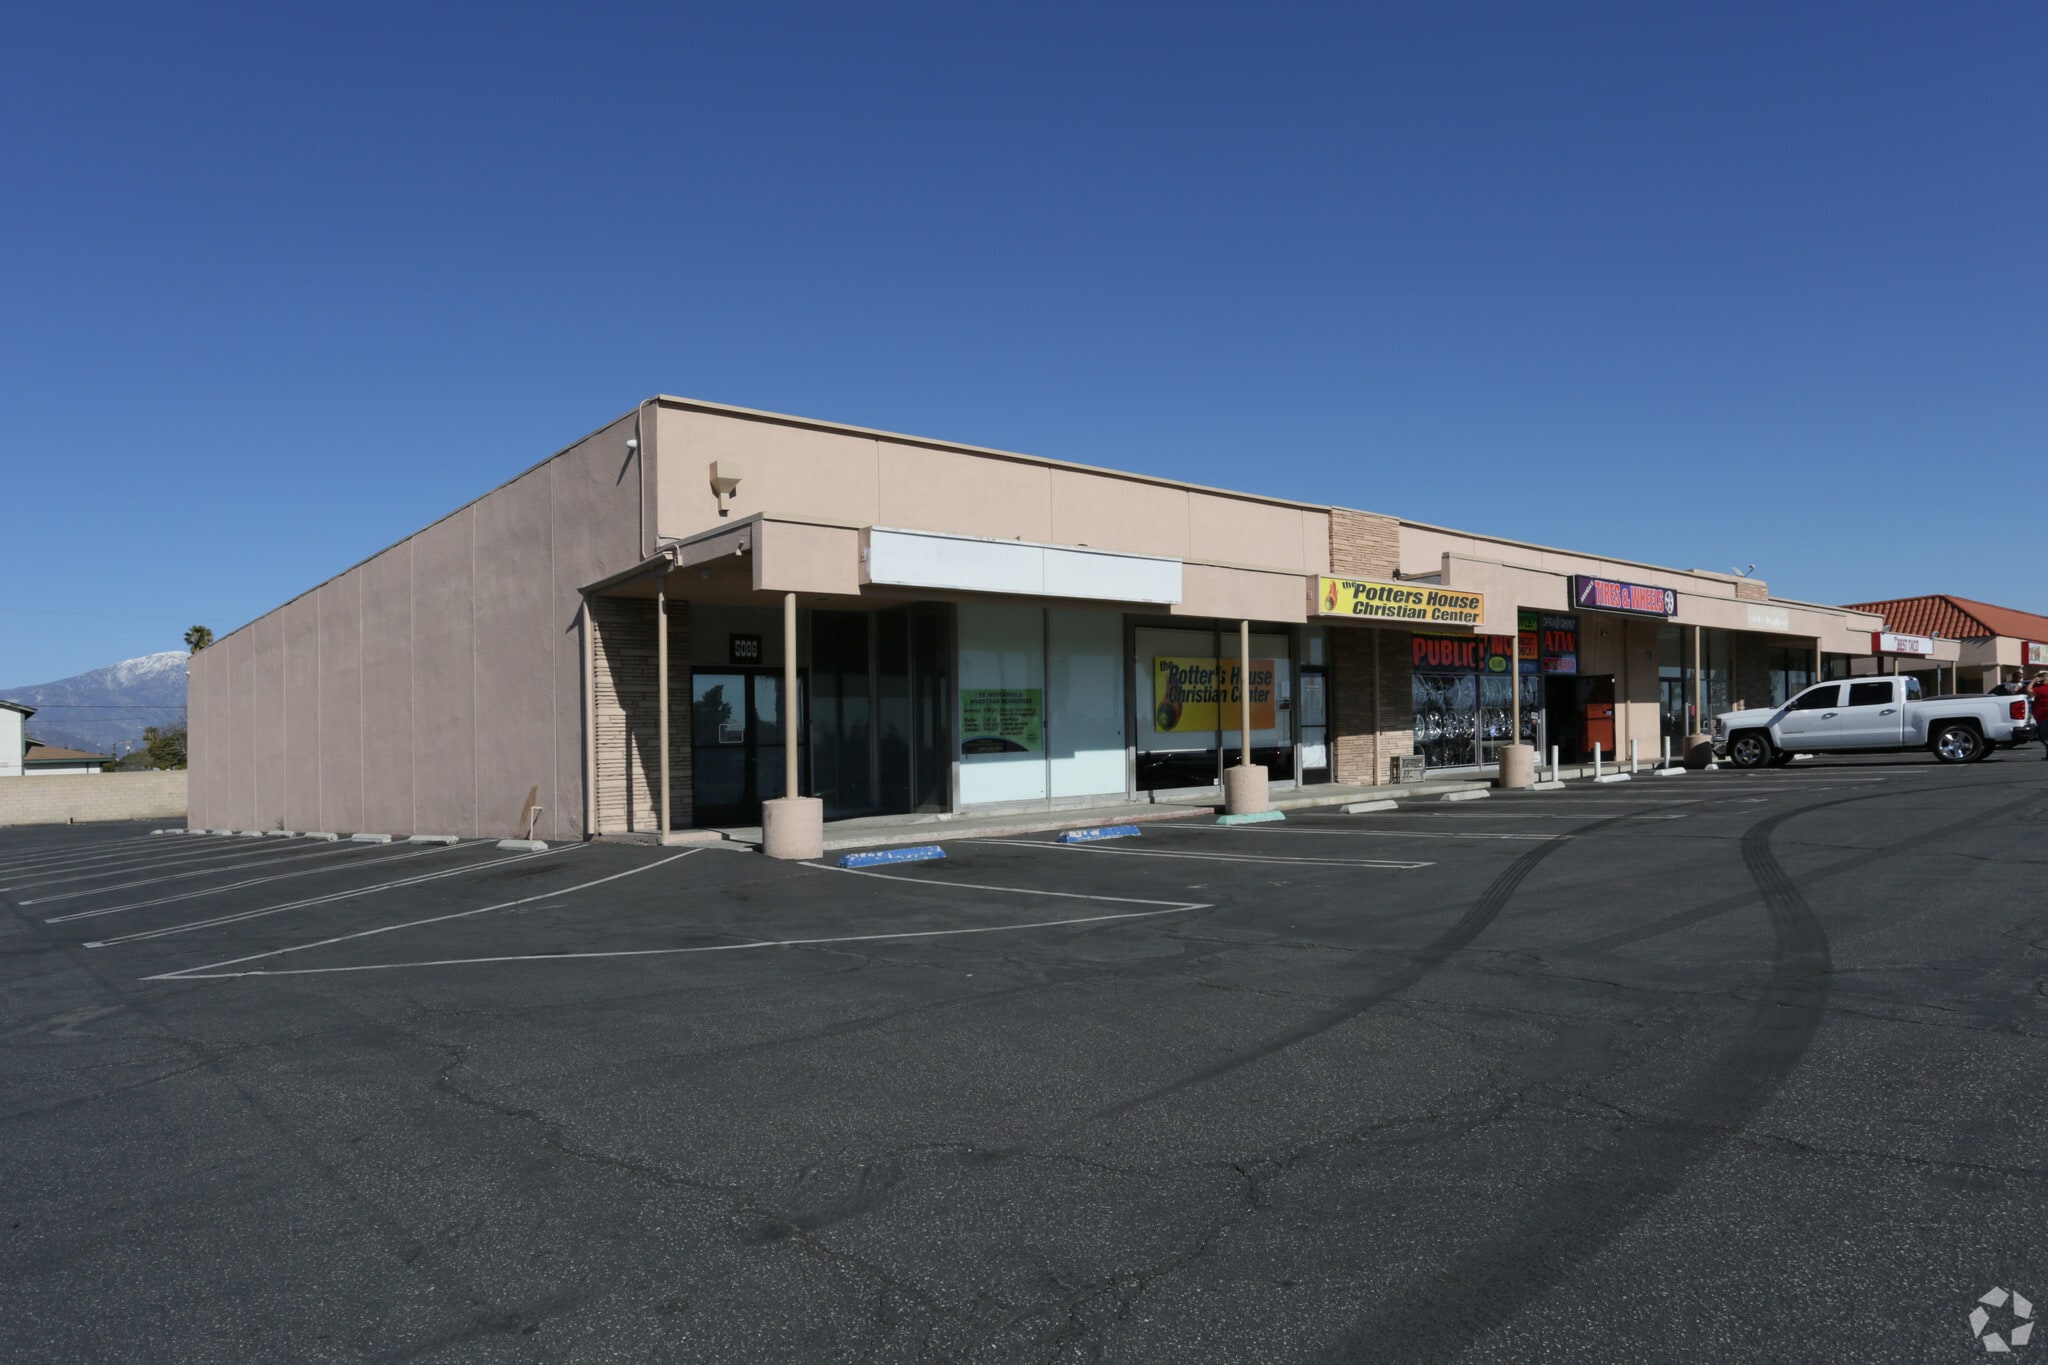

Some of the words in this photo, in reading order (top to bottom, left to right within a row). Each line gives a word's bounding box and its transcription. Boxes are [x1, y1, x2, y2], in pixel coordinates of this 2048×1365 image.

[1342, 581, 1357, 589] the
[1353, 583, 1423, 605] Potters
[1426, 591, 1479, 610] House
[1595, 580, 1621, 608] TIRES
[1621, 588, 1630, 608] &
[1630, 585, 1664, 613] WHEELS
[1352, 600, 1427, 619] Christian
[1431, 607, 1479, 623] Center
[735, 640, 758, 657] 5086
[1160, 660, 1173, 672] the
[1168, 664, 1226, 685] Potter's
[1230, 666, 1272, 685] Huse
[1168, 685, 1227, 704] Christian
